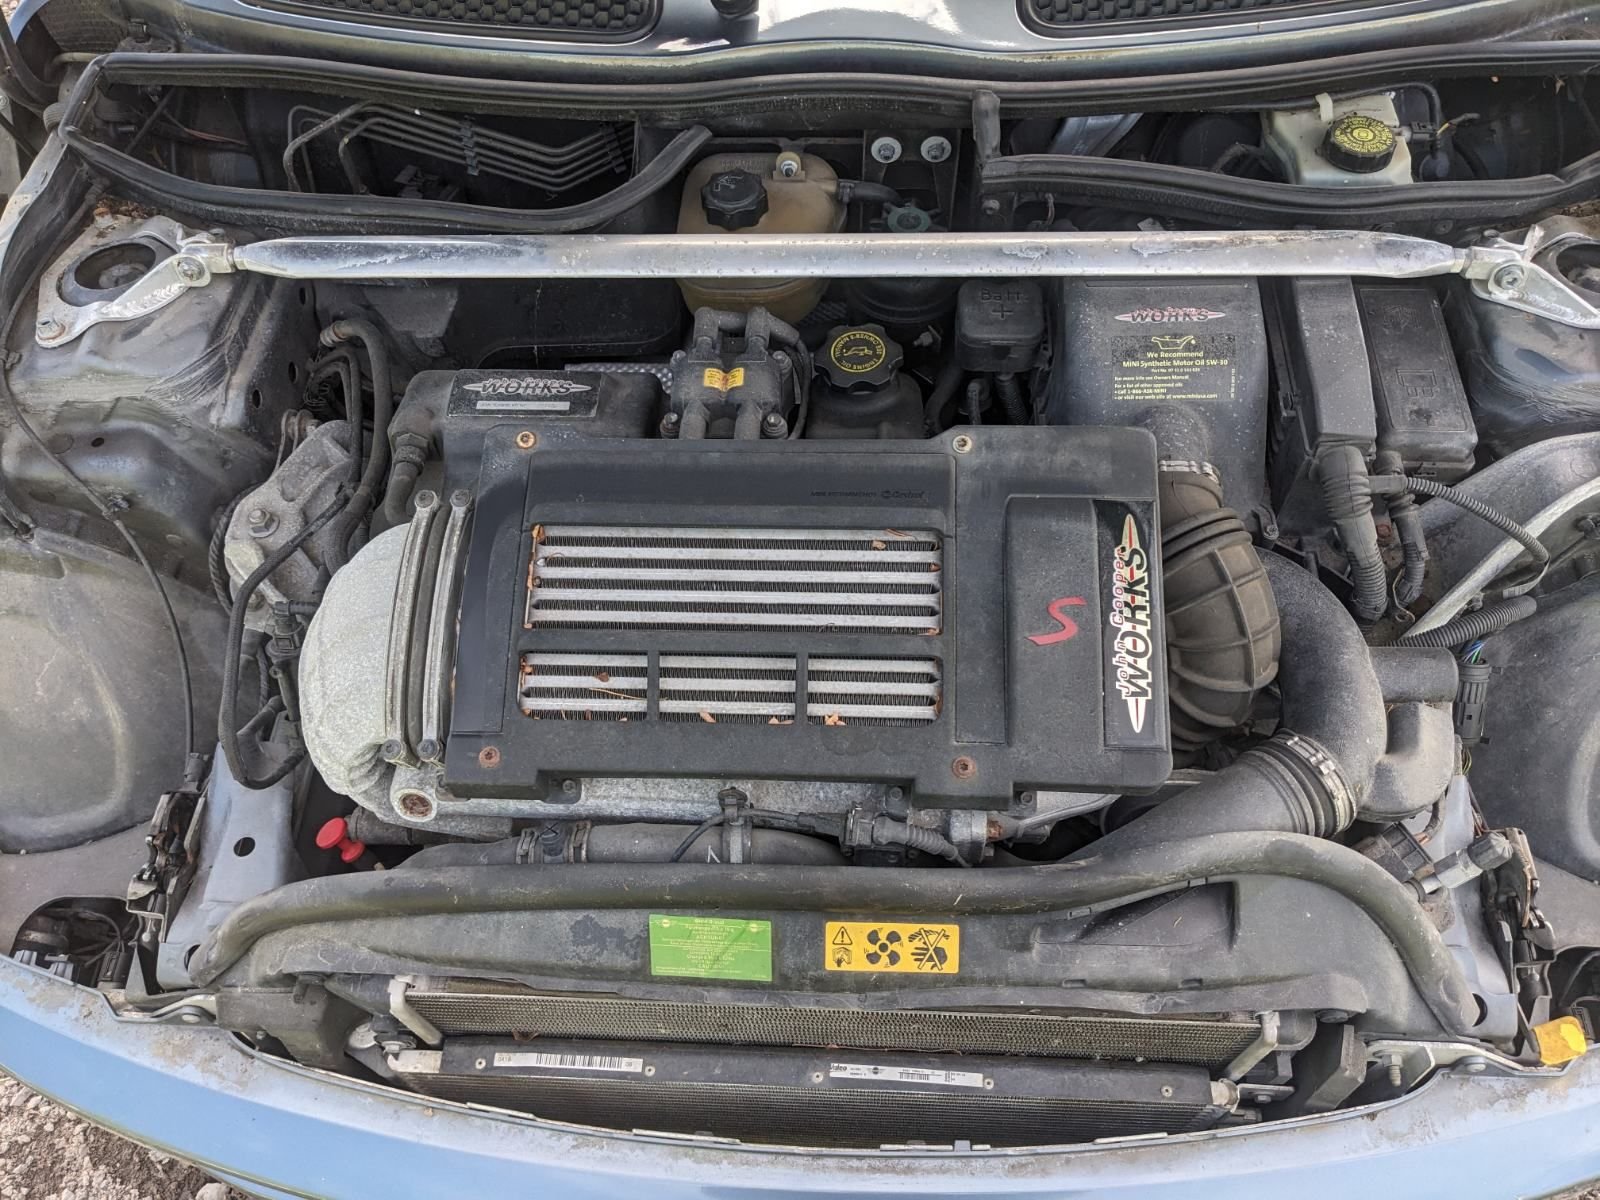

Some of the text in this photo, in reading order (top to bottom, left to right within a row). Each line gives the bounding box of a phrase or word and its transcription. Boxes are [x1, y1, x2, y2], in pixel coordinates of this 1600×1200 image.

[1131, 310, 1209, 322] WORKS
[1140, 360, 1172, 368] Synthetic
[481, 380, 572, 395] WORKS
[1025, 596, 1088, 647] S
[1110, 545, 1131, 695] John Cooper
[1121, 547, 1151, 699] WORKS
